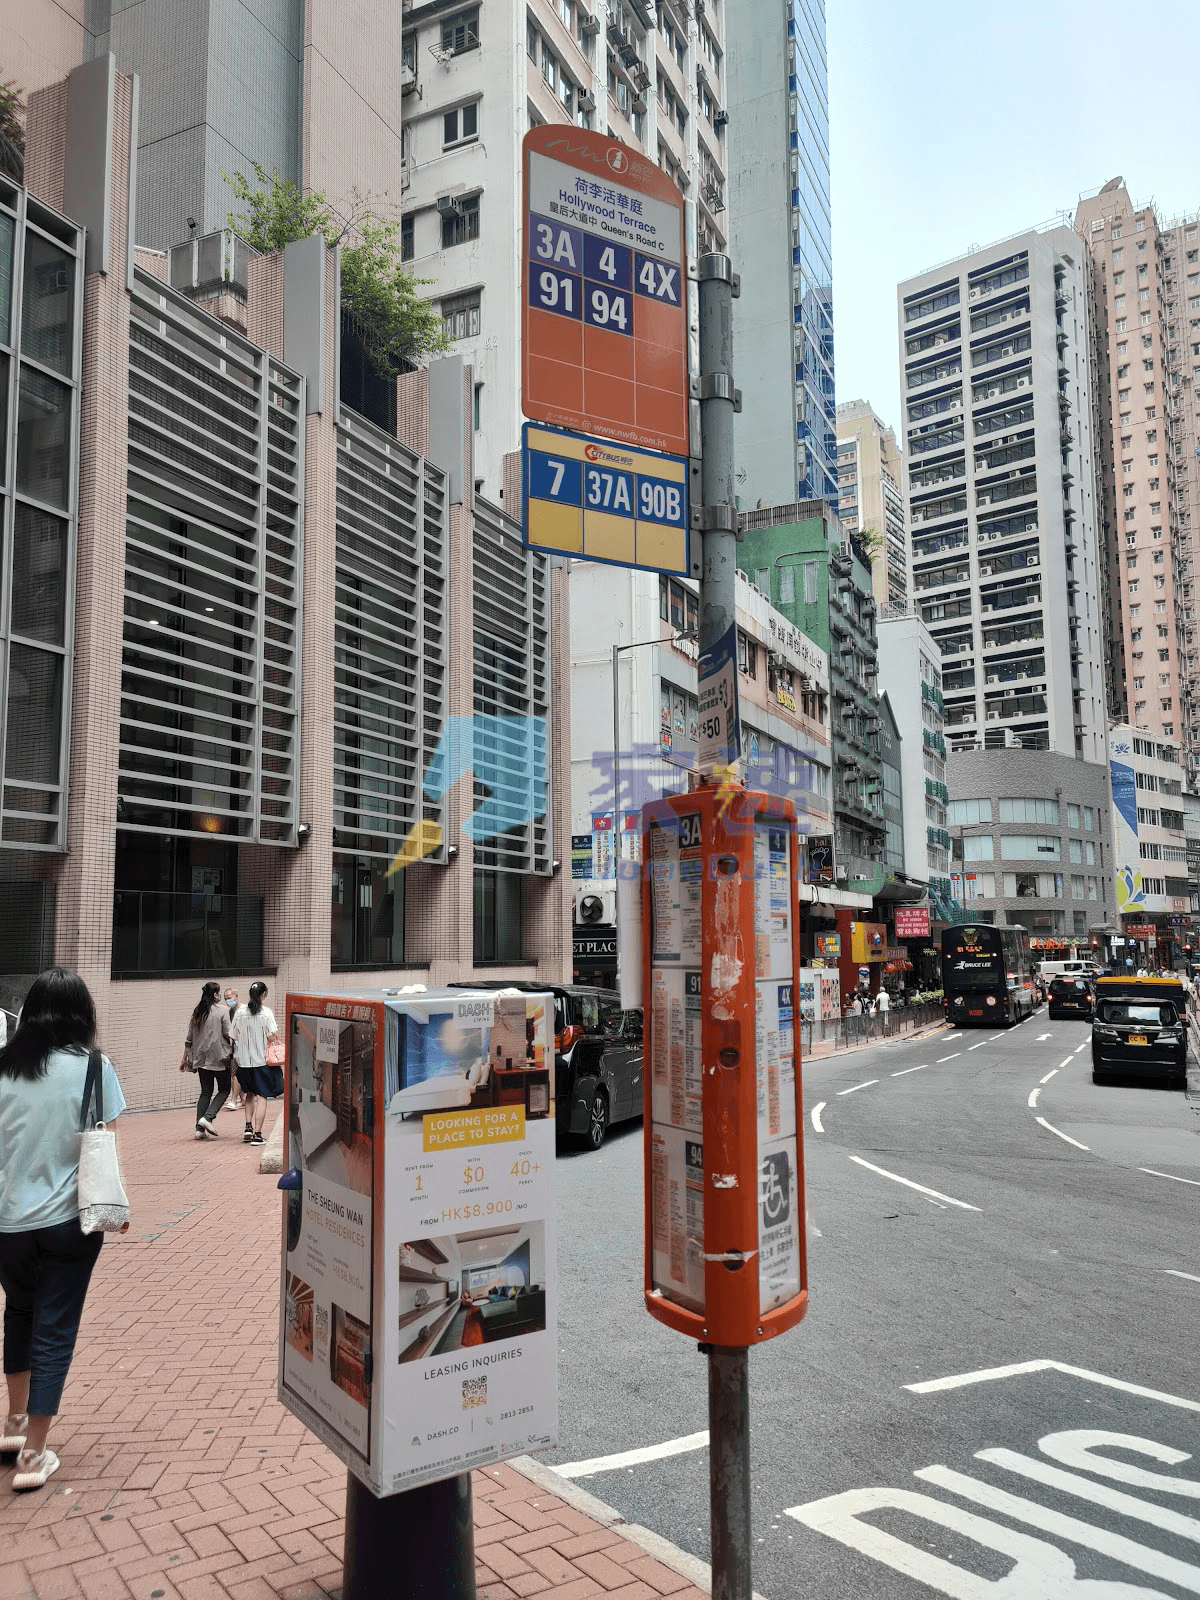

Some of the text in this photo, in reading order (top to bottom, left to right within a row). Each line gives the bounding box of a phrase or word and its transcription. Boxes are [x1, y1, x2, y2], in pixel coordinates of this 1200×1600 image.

[575, 177, 643, 215] 荷李活華庭
[559, 189, 656, 234] Hollywood Terrace
[549, 202, 665, 251] 皇后大道中 Queen's Road C
[537, 224, 677, 301] 3A 4 4X
[540, 272, 627, 330] 91 94
[593, 424, 667, 448] www.nwfb.com.hk
[591, 450, 620, 462] CITYBUS
[548, 460, 681, 520] 7 37A 90B
[681, 815, 702, 846] 3A
[586, 942, 617, 952] PLAC
[458, 1002, 490, 1018] DASH
[429, 1124, 520, 1144] PLACE TO STAY?
[430, 1112, 518, 1131] LOOKING FOR A
[463, 1165, 485, 1186] $0
[509, 1160, 541, 1177] 40+
[415, 1175, 424, 1191] 1
[458, 1186, 489, 1194] COMMISSION
[308, 1189, 363, 1226] THE SHEUNG WAN
[409, 1194, 429, 1202] MONTH
[420, 1218, 439, 1226] FROM
[441, 1199, 513, 1223] HK$8,900
[325, 1216, 365, 1248] RESIDENCES
[424, 1348, 523, 1380] LEASING INQUIRIES
[427, 1405, 534, 1441] DASH.CO 2813 2853
